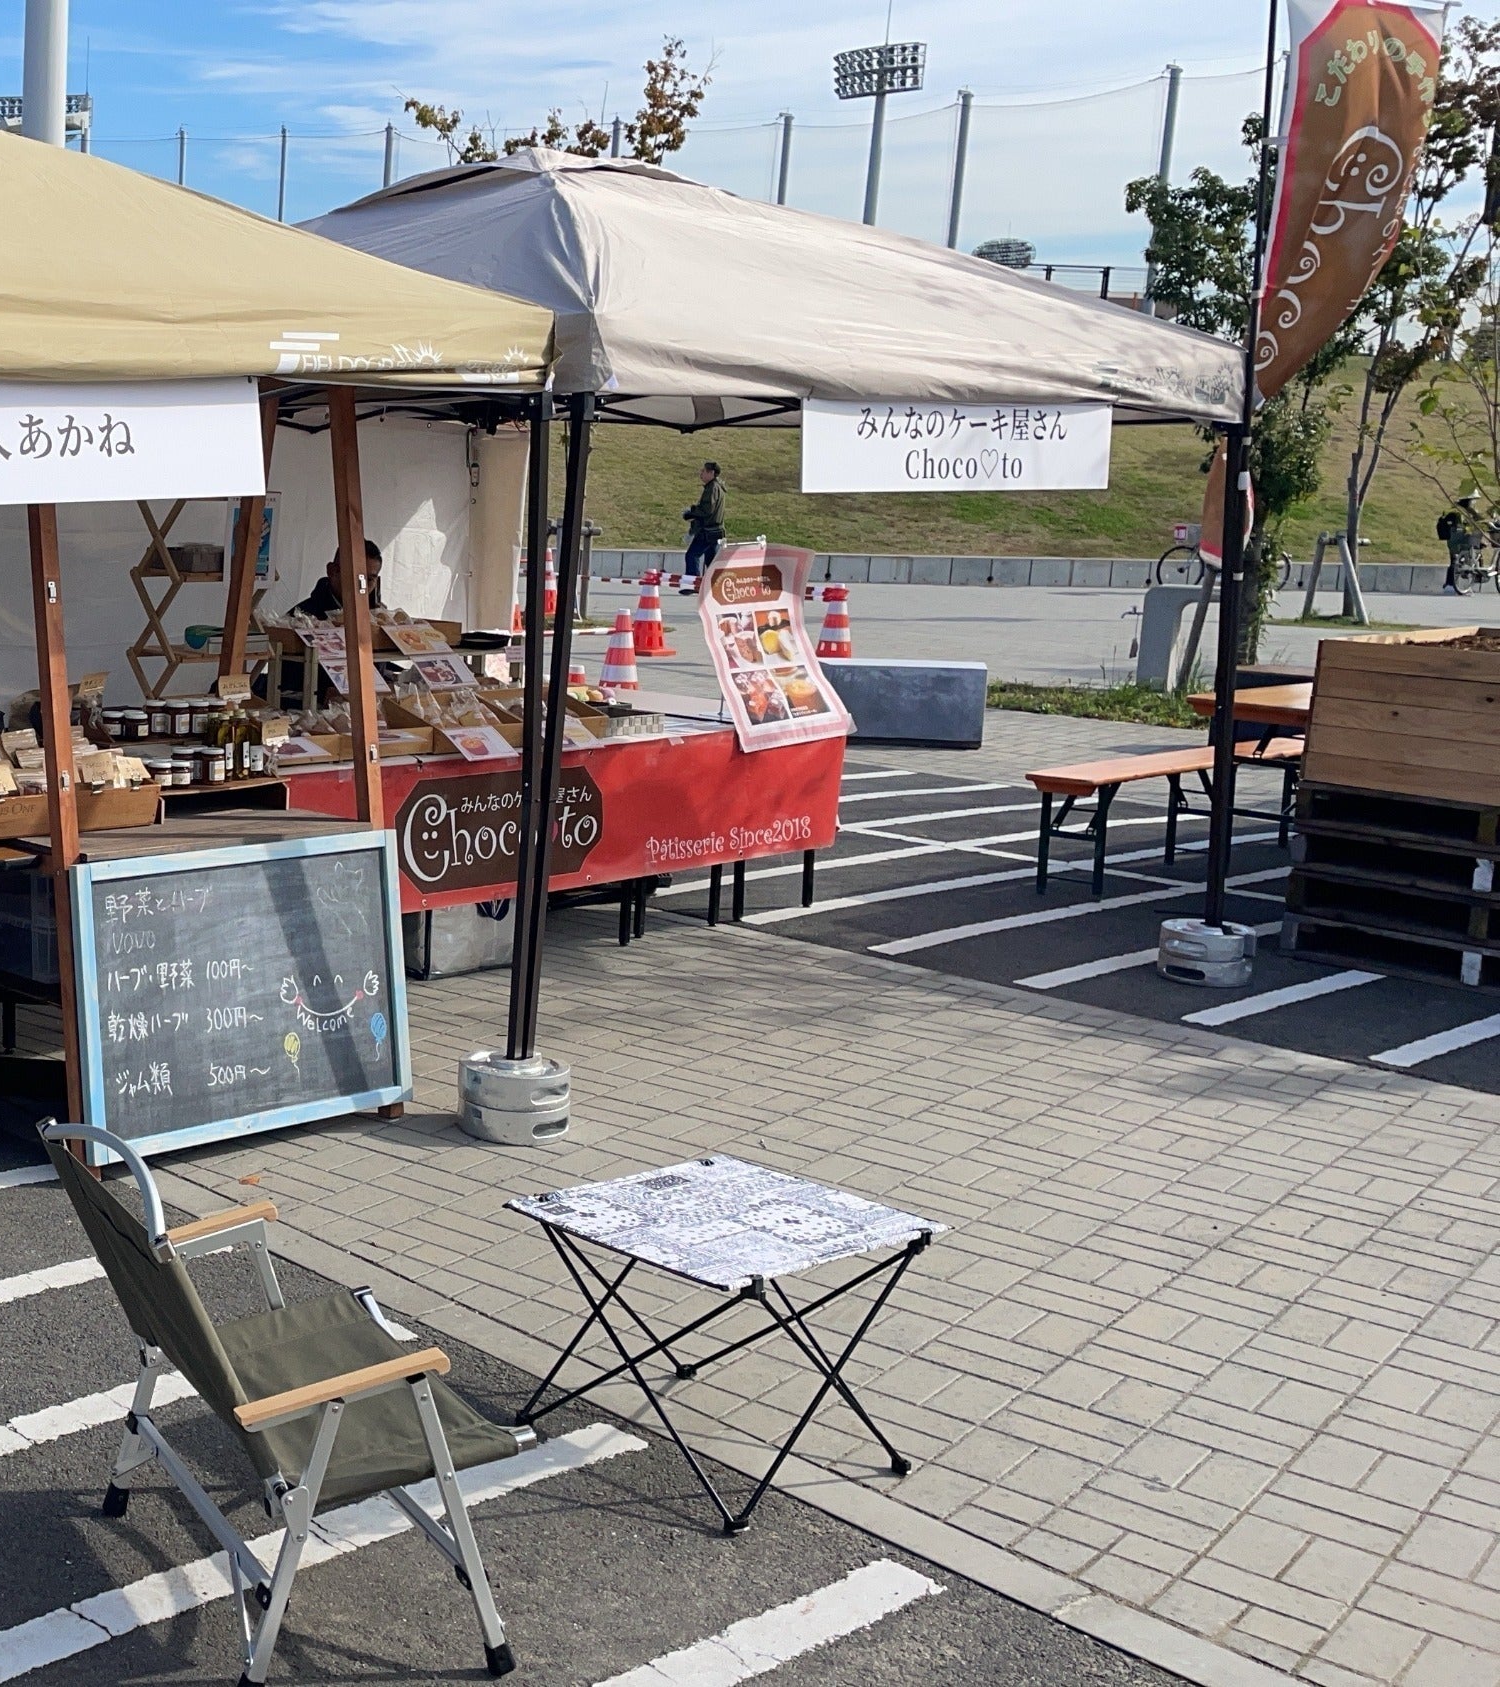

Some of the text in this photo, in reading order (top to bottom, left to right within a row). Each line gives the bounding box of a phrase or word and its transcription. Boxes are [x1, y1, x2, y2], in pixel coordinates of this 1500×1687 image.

[857, 406, 1068, 441] みんなのケーキ屋さん
[646, 831, 725, 863] Pâtisserie
[104, 886, 214, 925] 野菜とハーブ
[107, 1010, 190, 1043] 乾燥ハーブ
[115, 1062, 174, 1098] ジャム類
